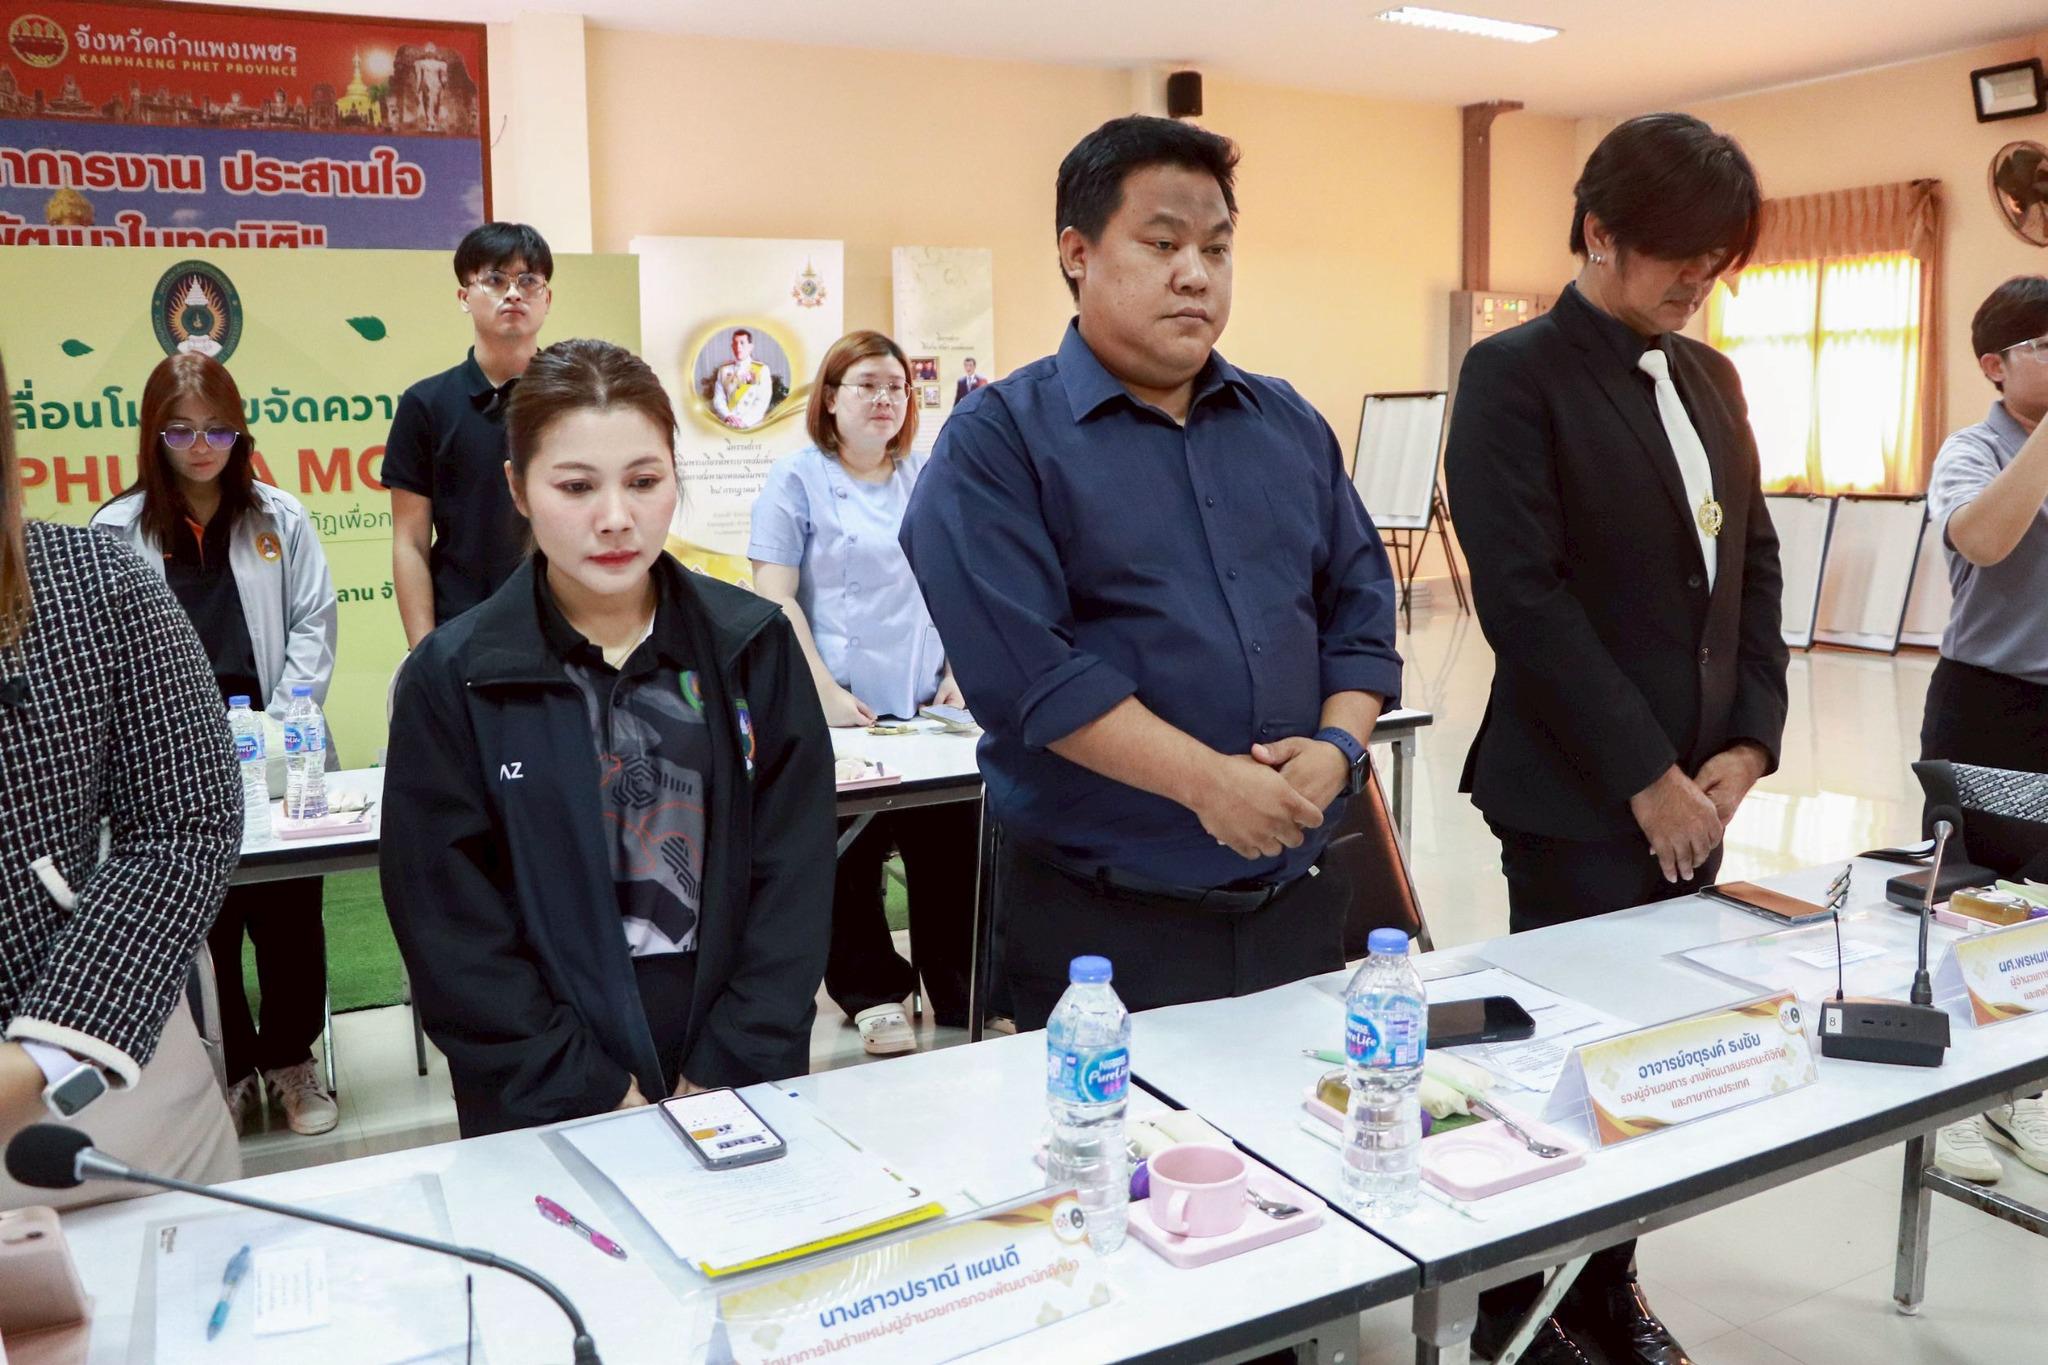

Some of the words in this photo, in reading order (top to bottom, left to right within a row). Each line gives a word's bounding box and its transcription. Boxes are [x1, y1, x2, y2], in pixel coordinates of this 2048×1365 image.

[74, 24, 298, 63] จังหวัดกำแพงเพชร
[79, 54, 176, 71] KAMPHAENG
[182, 61, 220, 73] PHET
[226, 63, 298, 77] PROVINCE
[223, 148, 423, 197] ประสานใจ
[1829, 1016, 1836, 1026] 8
[1638, 1039, 1726, 1079] อาจารย์จตุรงค์
[1728, 1032, 1761, 1053] ธงชัย
[1671, 1078, 1750, 1109] และภาษาต่างประเทศ
[819, 1264, 961, 1328] นางสาวปราณี
[965, 1244, 1020, 1281] แผนดี
